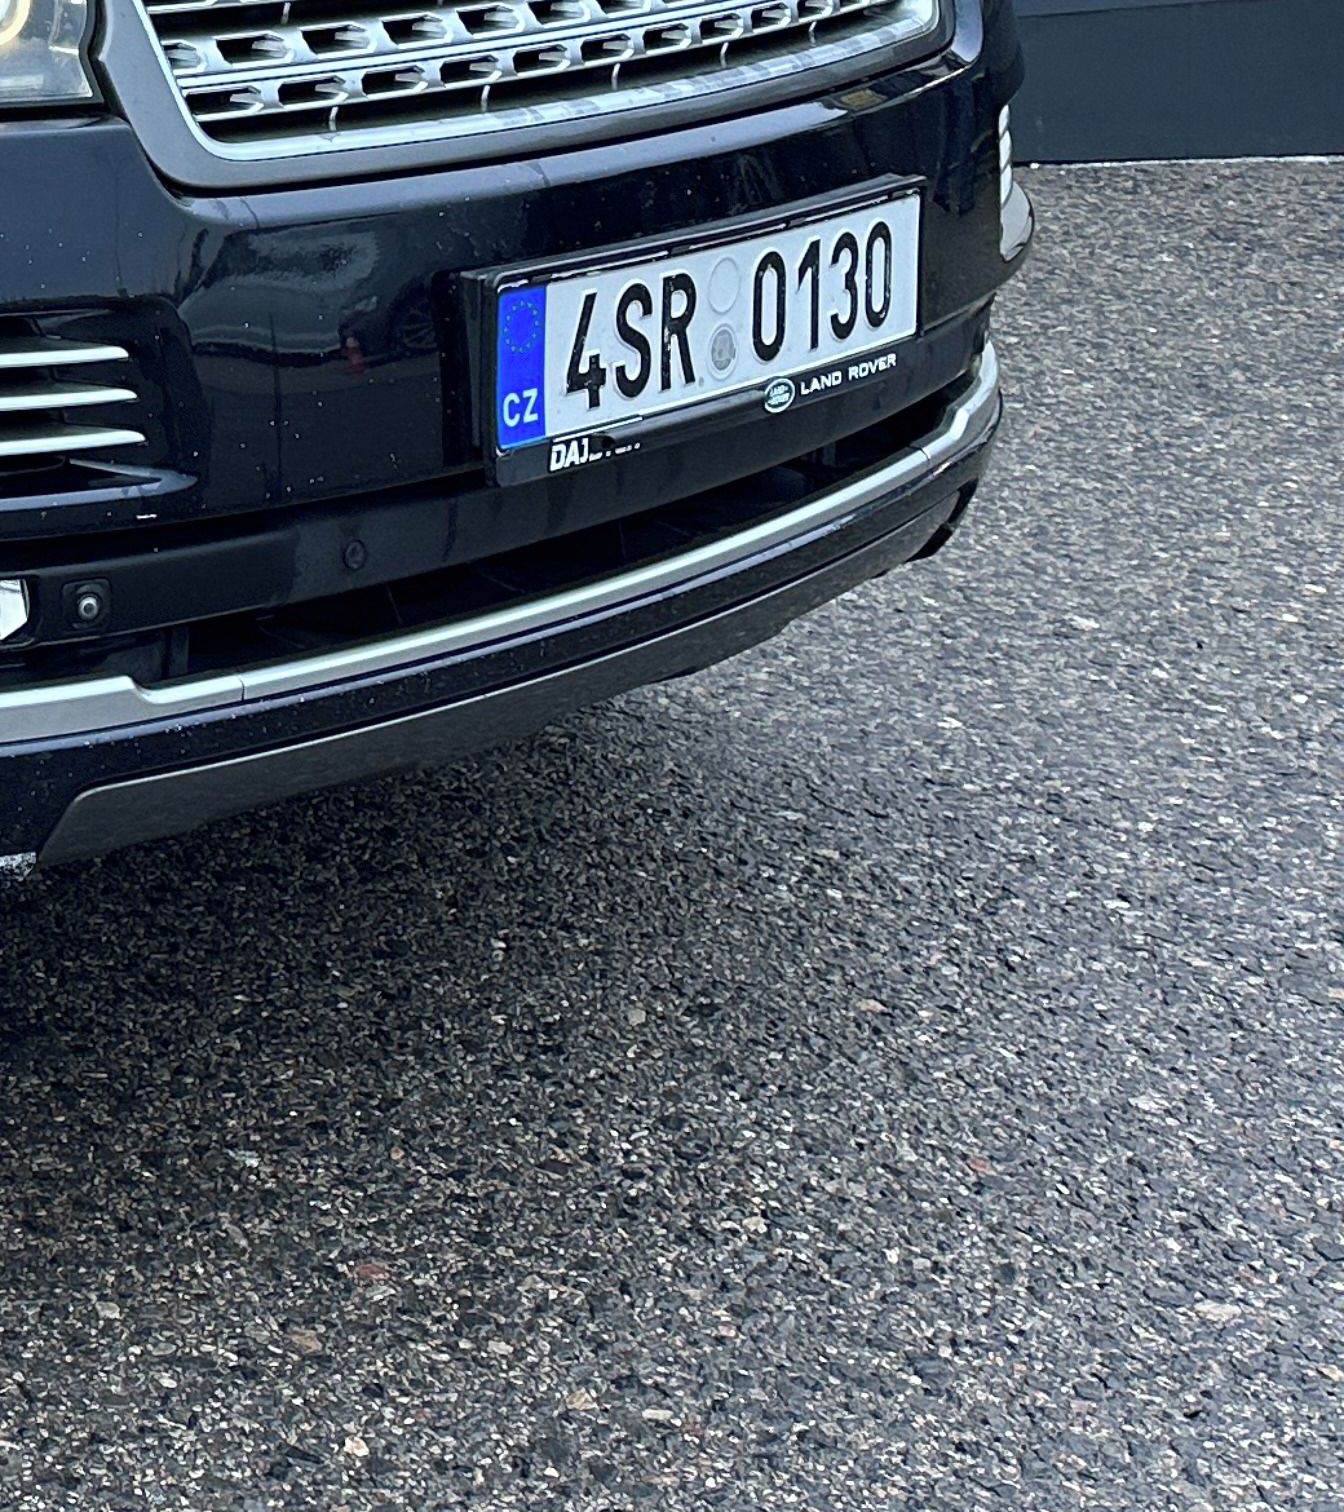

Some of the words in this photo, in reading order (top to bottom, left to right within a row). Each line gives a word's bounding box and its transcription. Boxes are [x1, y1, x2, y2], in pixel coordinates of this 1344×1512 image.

[565, 271, 697, 410] 4SR
[751, 220, 894, 363] 0130
[800, 370, 842, 395] LAND
[848, 353, 897, 381] ROVER
[503, 392, 539, 428] CZ
